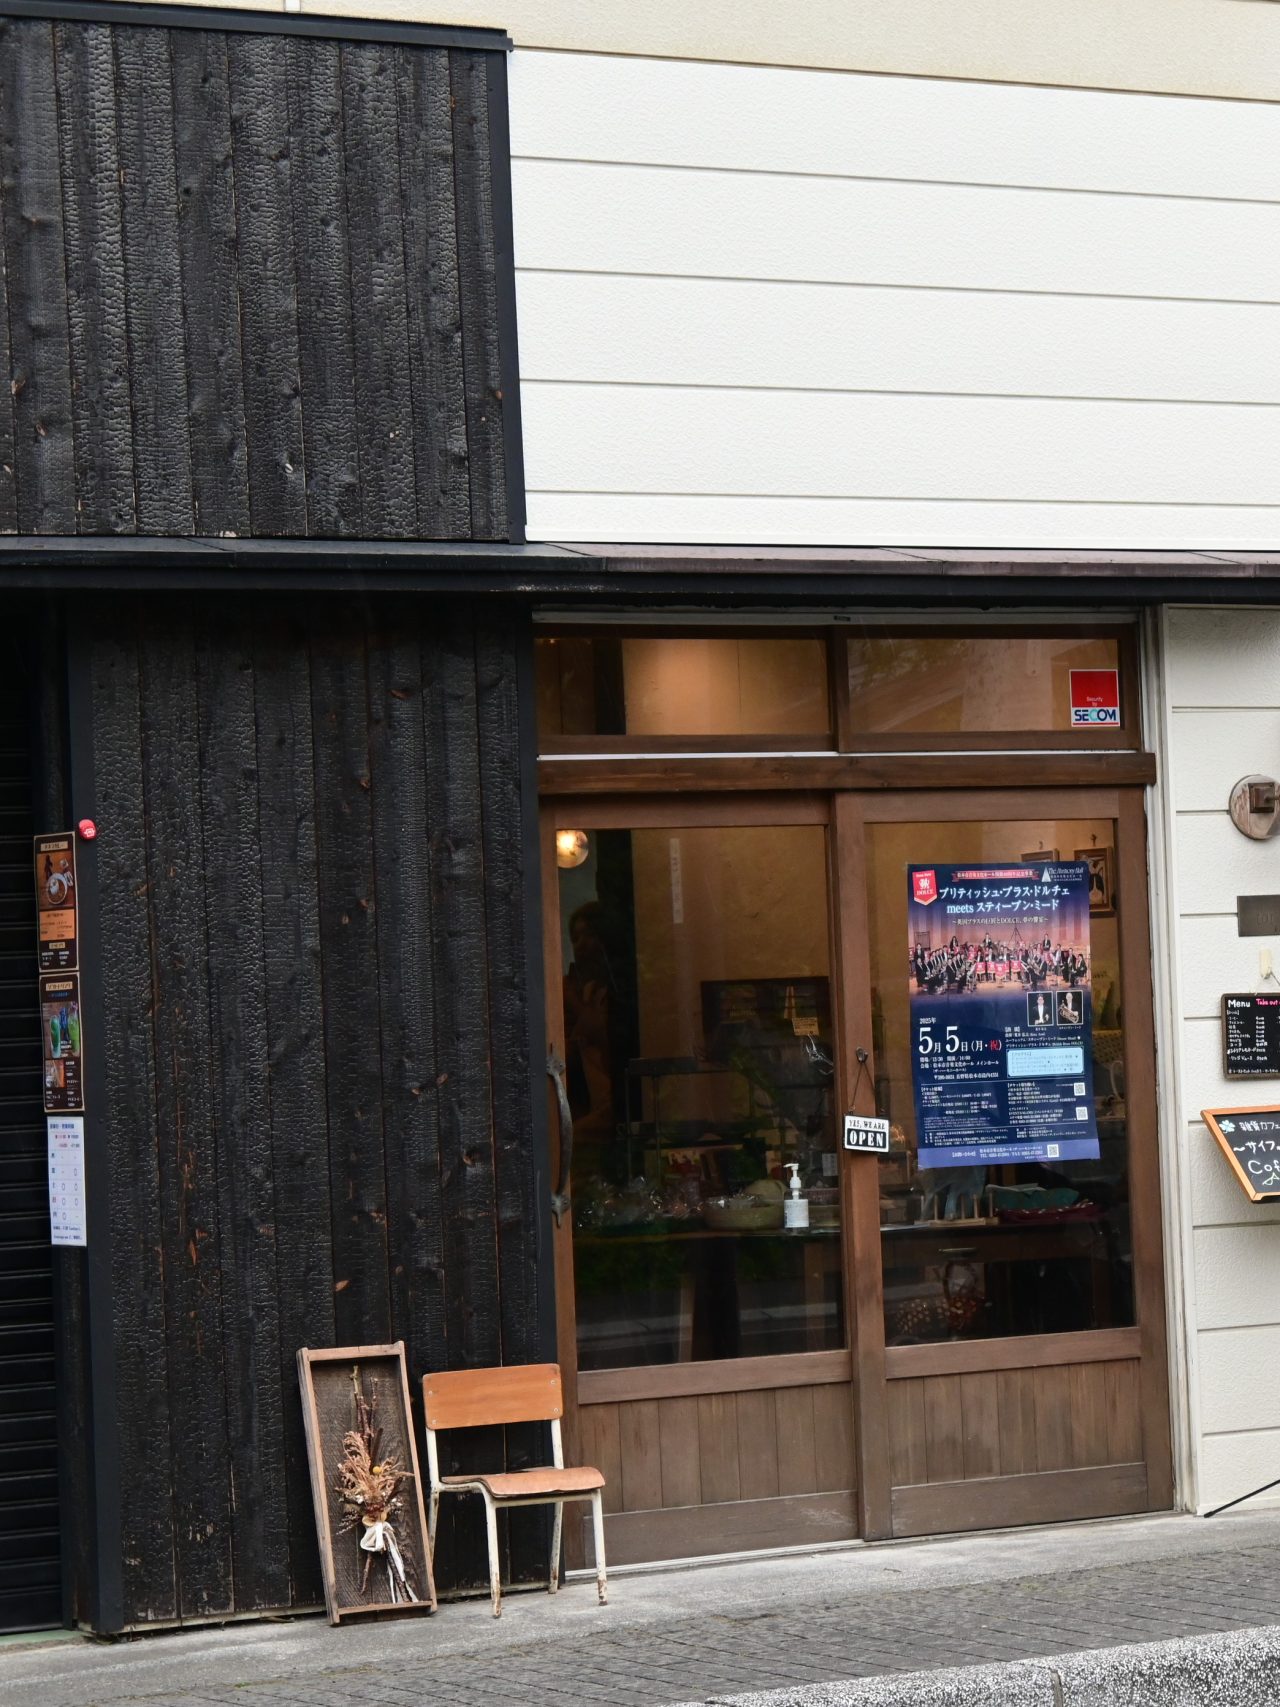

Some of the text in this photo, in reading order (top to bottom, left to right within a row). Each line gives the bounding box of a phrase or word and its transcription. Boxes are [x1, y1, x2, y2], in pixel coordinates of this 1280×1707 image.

[1074, 709, 1116, 721] SECOM
[946, 904, 974, 913] meets
[1228, 999, 1251, 1008] Menu
[850, 1130, 884, 1147] OPEN
